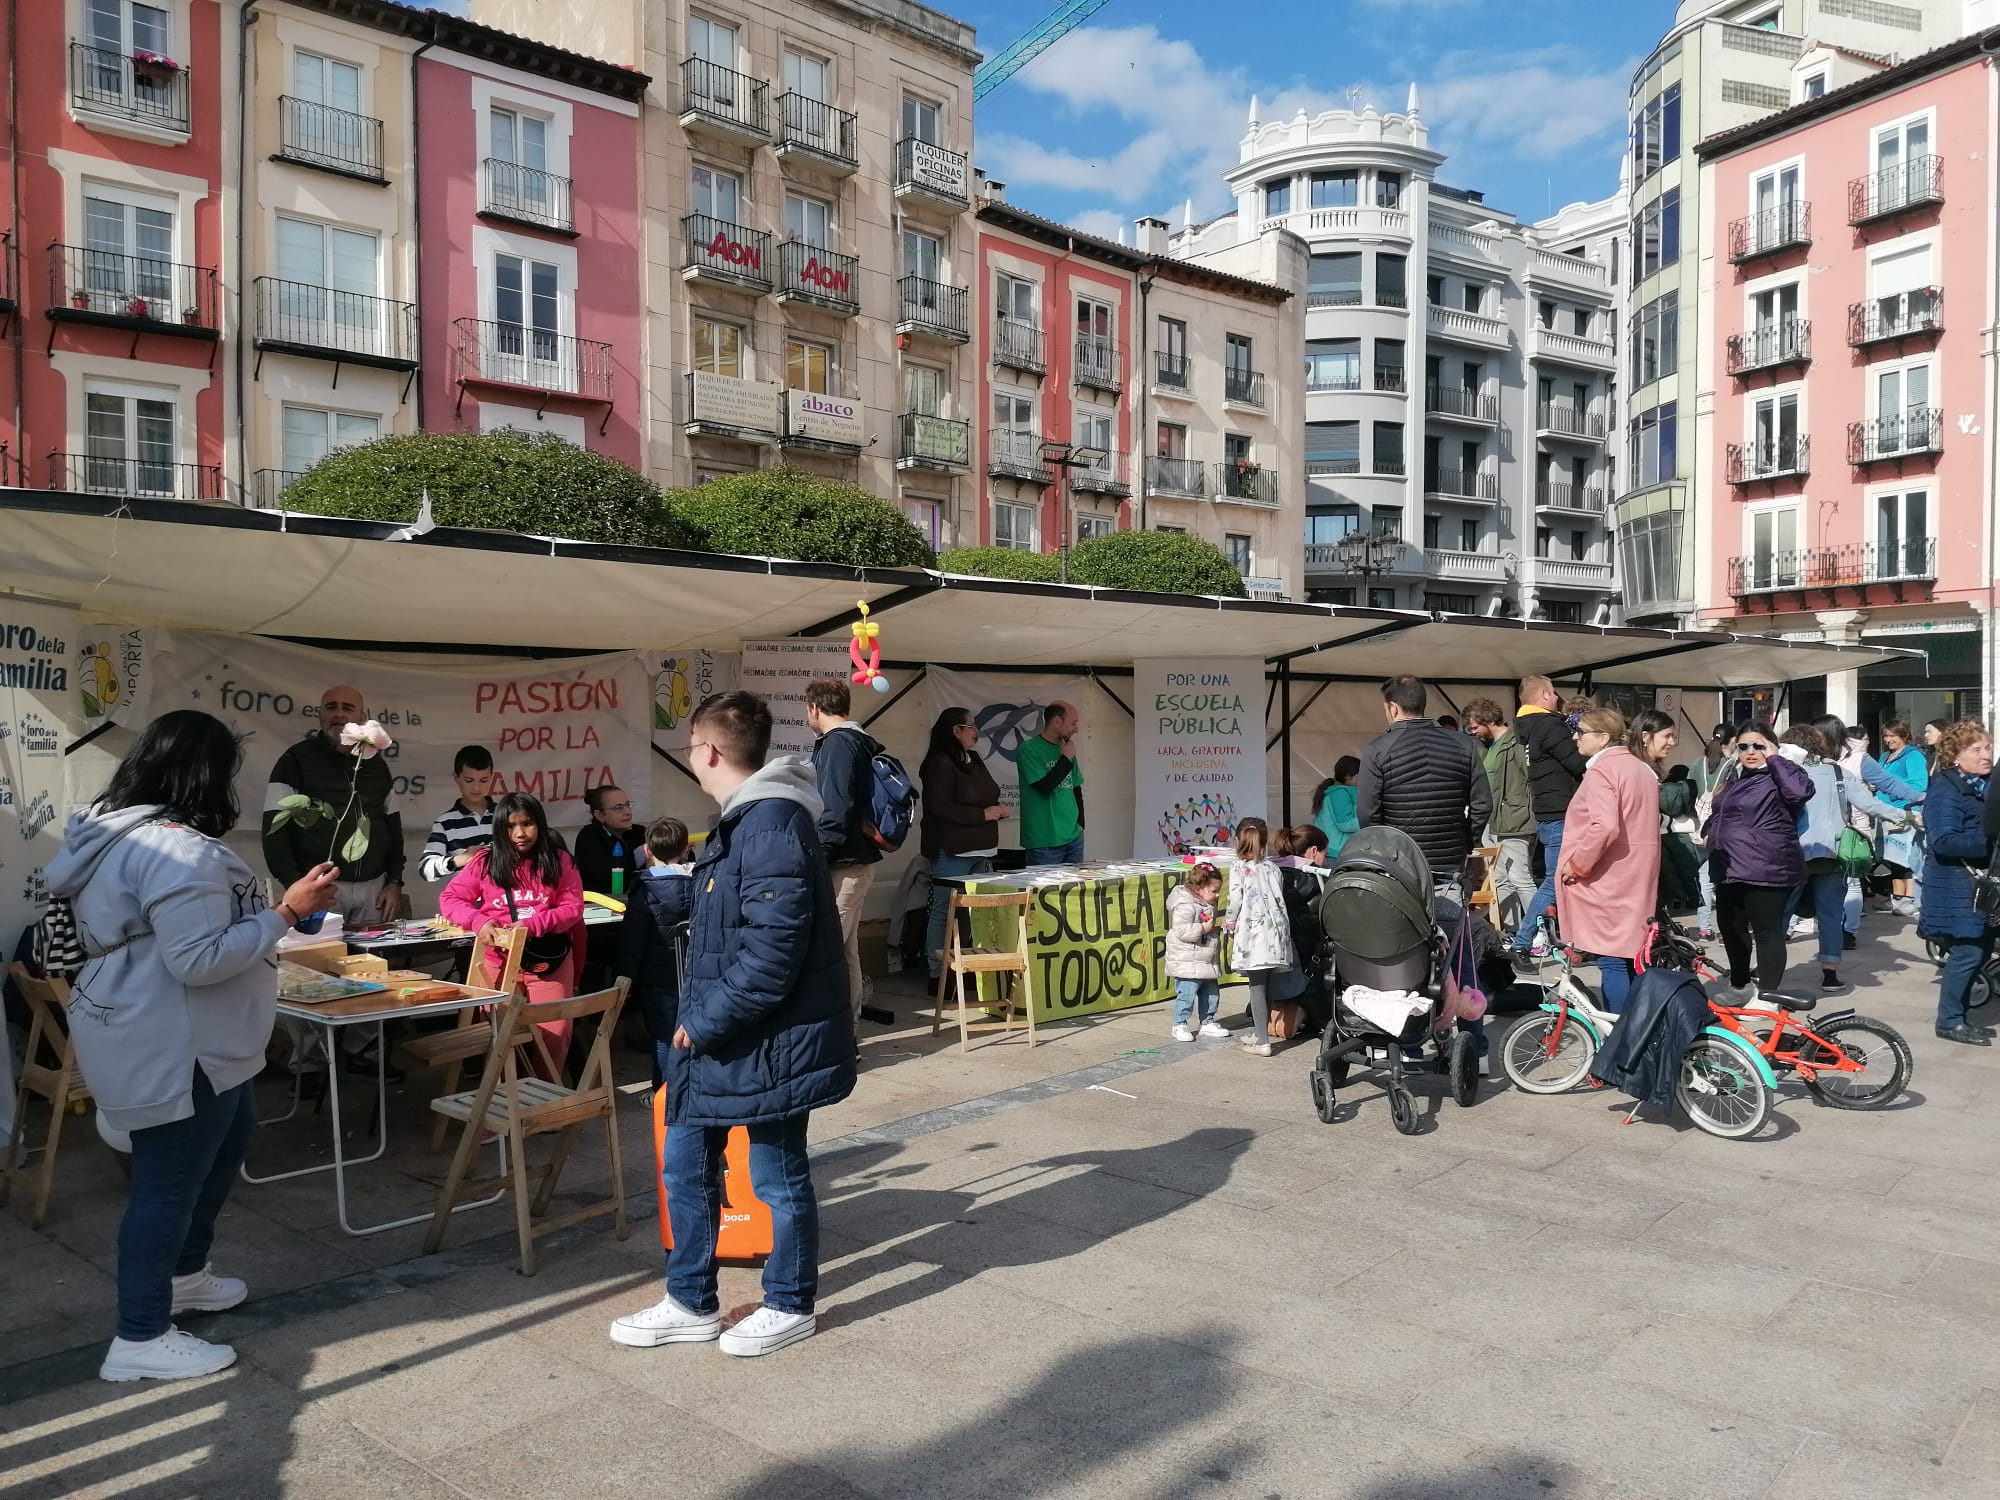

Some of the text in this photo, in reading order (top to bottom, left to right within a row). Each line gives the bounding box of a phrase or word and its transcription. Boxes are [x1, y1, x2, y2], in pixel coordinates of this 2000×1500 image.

[915, 142, 963, 167] ALQUILER
[917, 155, 962, 180] OFICINAS
[801, 394, 854, 417] ábaco
[1880, 621, 1939, 633] CALZADOS
[1167, 673, 1231, 687] POR UNA
[219, 680, 294, 716] foro
[476, 670, 618, 714] PASIÓN
[1155, 694, 1245, 713] ESCUELA
[377, 708, 400, 725] de
[406, 709, 422, 726] la
[1159, 712, 1242, 736] PÚBLICA
[27, 726, 44, 738] foro
[500, 725, 601, 753] POR LA
[27, 738, 58, 751] familia
[1191, 746, 1242, 756] GRATUITA
[1171, 760, 1228, 769] INCLUSIVA
[487, 765, 617, 803] AMILIA
[1165, 773, 1234, 783] Y DE CALIDAD
[1036, 938, 1148, 1009] TOD@S
[723, 1213, 751, 1222] boca
